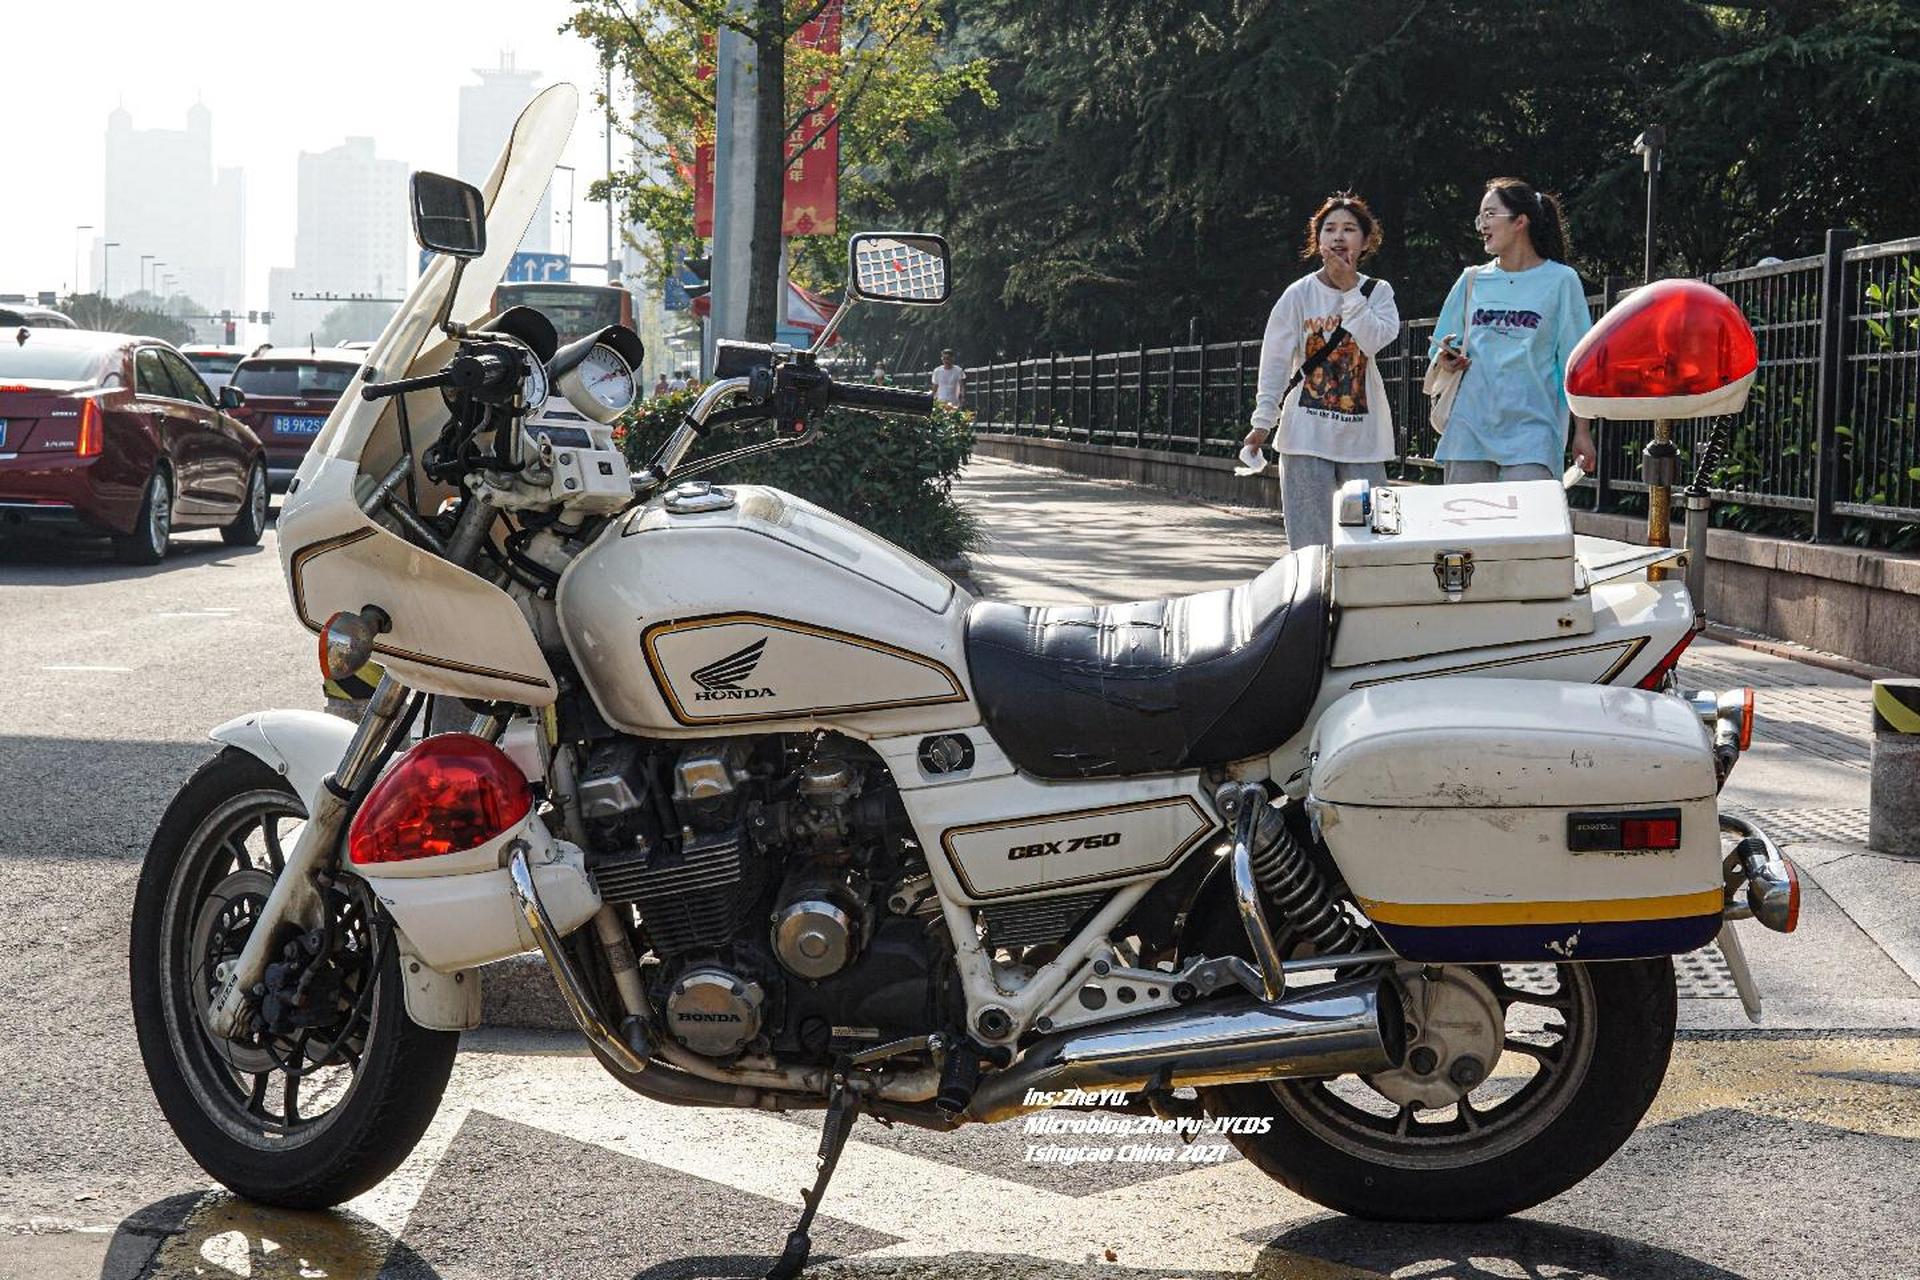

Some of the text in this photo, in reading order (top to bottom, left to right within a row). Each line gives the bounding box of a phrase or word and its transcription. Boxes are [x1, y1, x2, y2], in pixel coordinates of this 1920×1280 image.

[1442, 495, 1518, 526] 12
[695, 687, 777, 701] HONDA
[1007, 832, 1122, 861] CBX 750
[677, 1013, 742, 1023] HONDA
